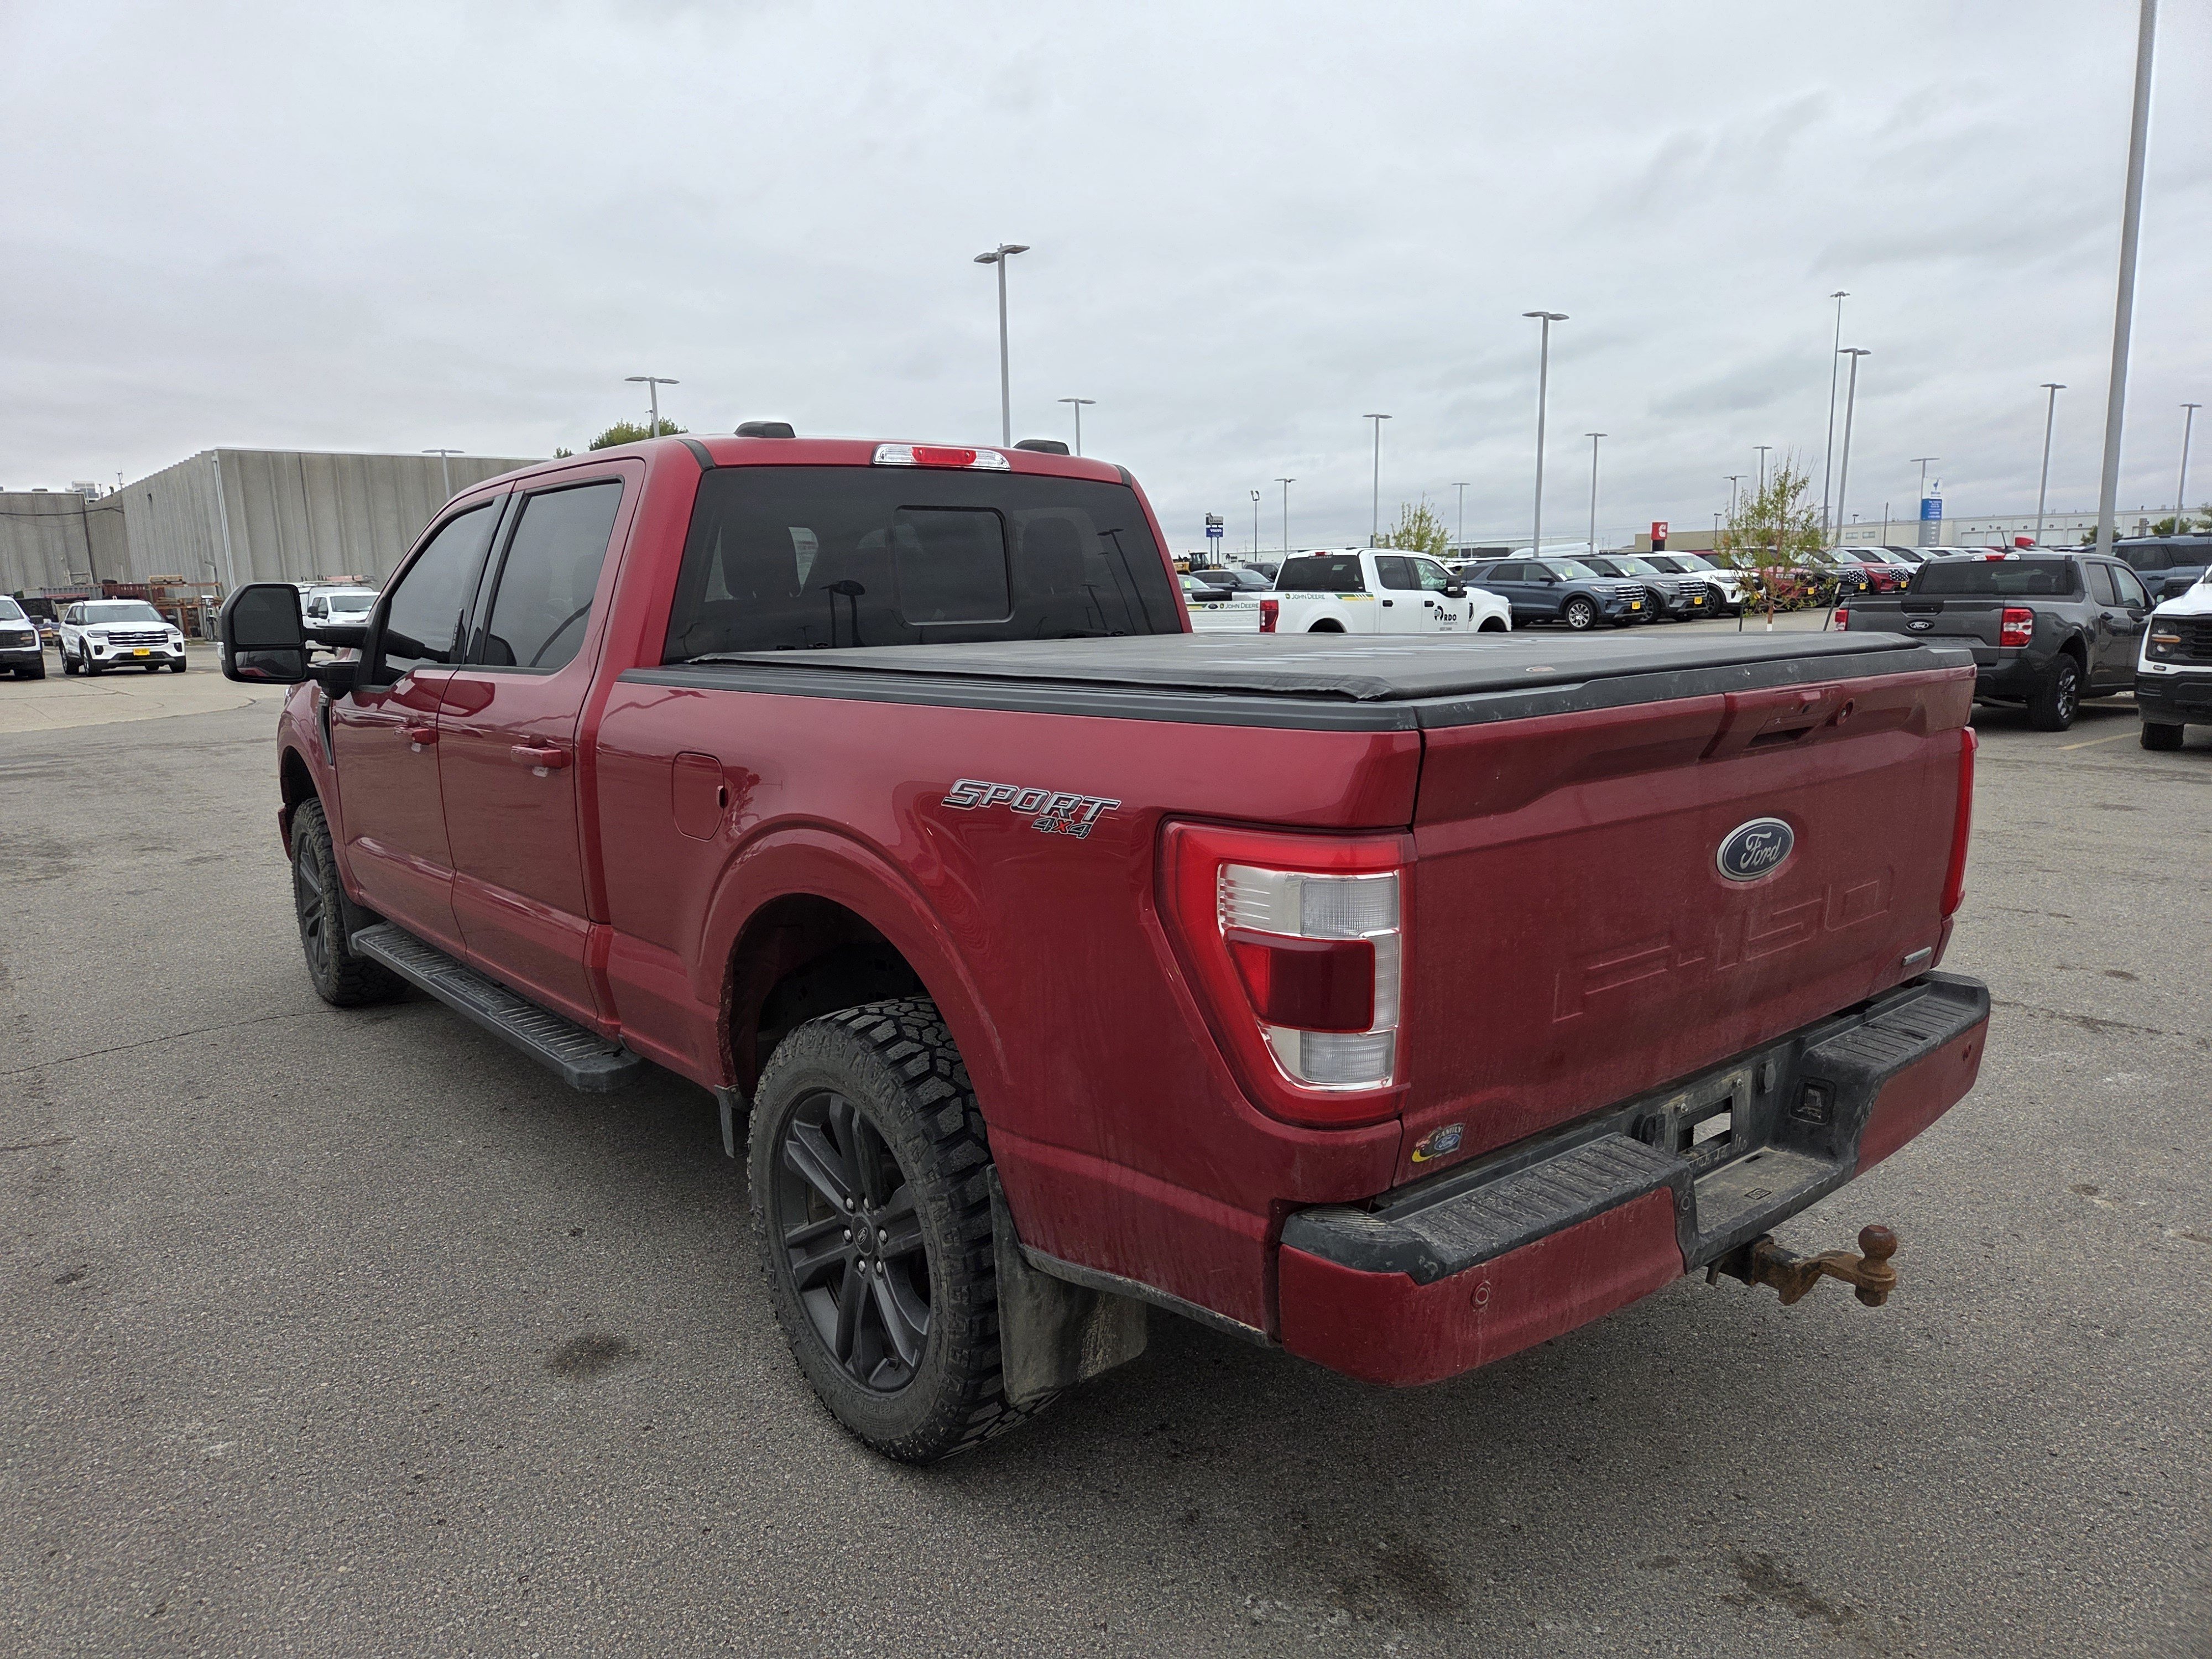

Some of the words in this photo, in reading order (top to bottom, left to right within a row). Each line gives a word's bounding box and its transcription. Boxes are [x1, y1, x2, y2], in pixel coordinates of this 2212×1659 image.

[941, 778, 1122, 823] SPORT
[1740, 831, 1782, 869] Ford
[1552, 863, 1894, 1023] F-150
[1434, 1125, 1463, 1142] FAMILY
